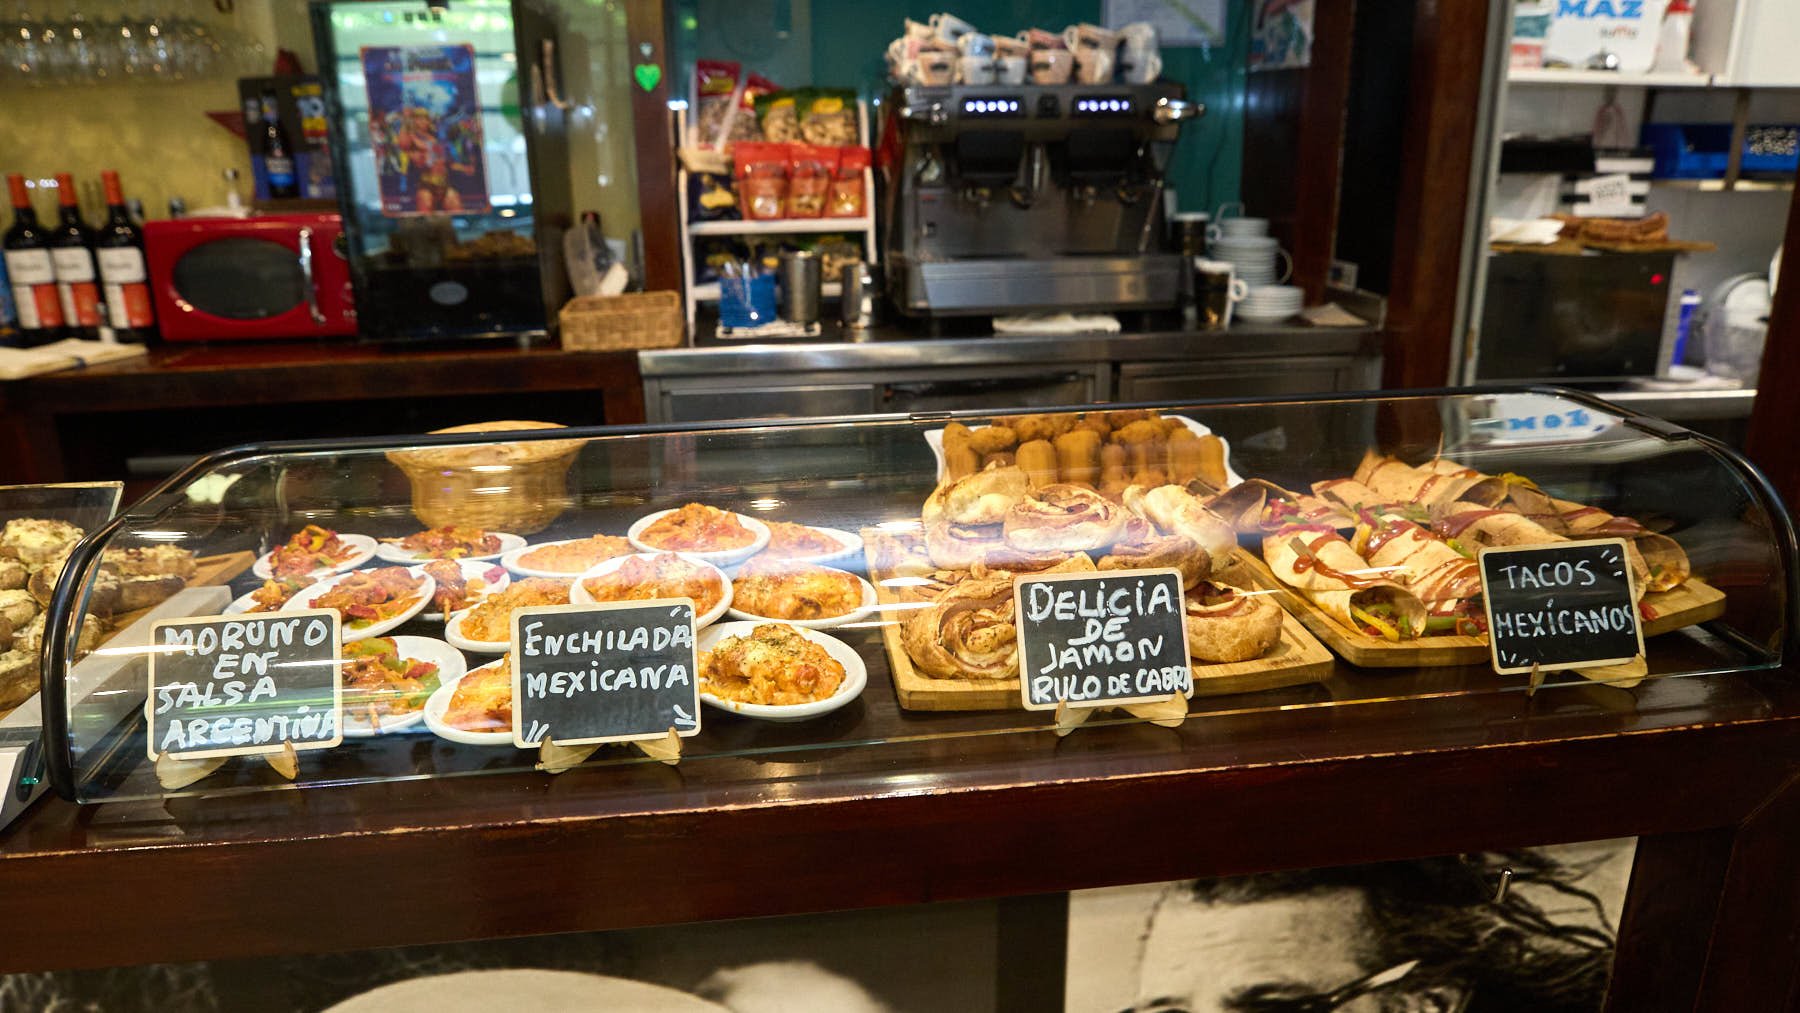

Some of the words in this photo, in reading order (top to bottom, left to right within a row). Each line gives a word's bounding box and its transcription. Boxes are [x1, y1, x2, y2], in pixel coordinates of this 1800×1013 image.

[1499, 560, 1596, 589] TACOS
[164, 619, 328, 657] MORUNO
[525, 621, 692, 656] ENCHILADA
[1067, 616, 1130, 645] DE
[213, 652, 279, 679] EN
[1040, 635, 1163, 674] JAMON
[155, 676, 277, 715] SALSA
[1032, 674, 1101, 703] RULO
[1108, 673, 1132, 696] DE
